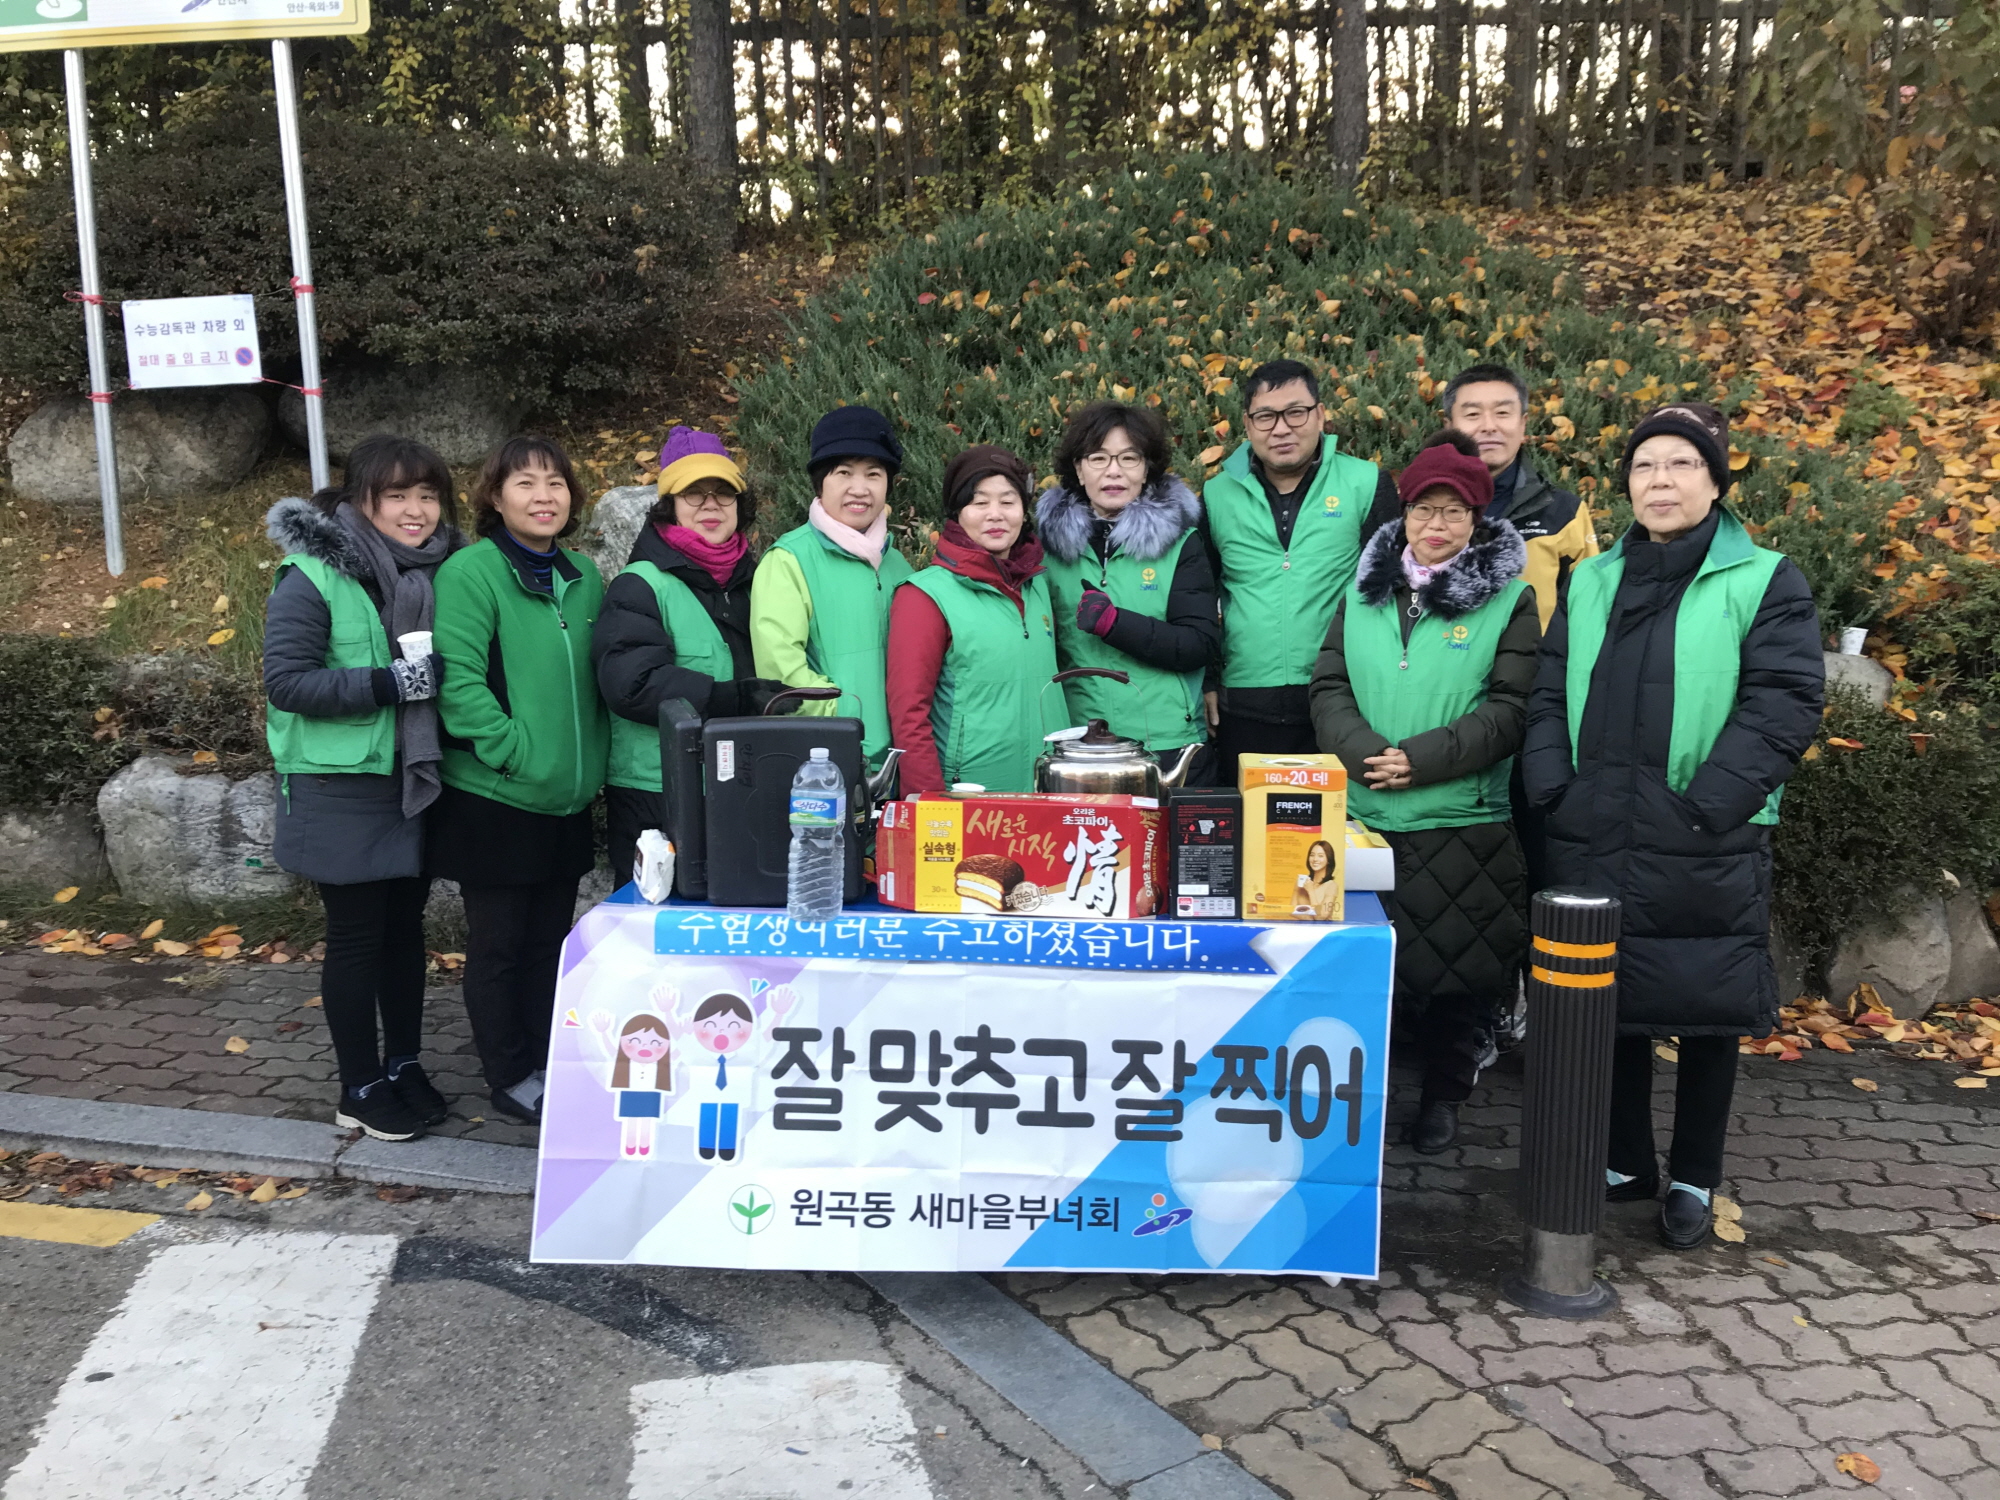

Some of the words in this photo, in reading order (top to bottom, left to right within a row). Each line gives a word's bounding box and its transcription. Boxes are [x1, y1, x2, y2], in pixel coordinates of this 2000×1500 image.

[134, 321, 196, 337] 수능감독관
[202, 319, 227, 333] 차량
[233, 318, 245, 331] 외
[138, 354, 160, 367] 절대
[1072, 807, 1096, 816] 오리온
[1276, 801, 1312, 809] FRENCH
[965, 808, 1028, 841] 새로운
[1062, 814, 1109, 827] 초코파이
[923, 842, 956, 856] 실속형
[1007, 831, 1058, 872] 시작
[922, 919, 1209, 962] 수고하셨습니다.
[790, 1188, 896, 1229] 원곡동
[908, 1192, 1121, 1232] 새마을부녀회
